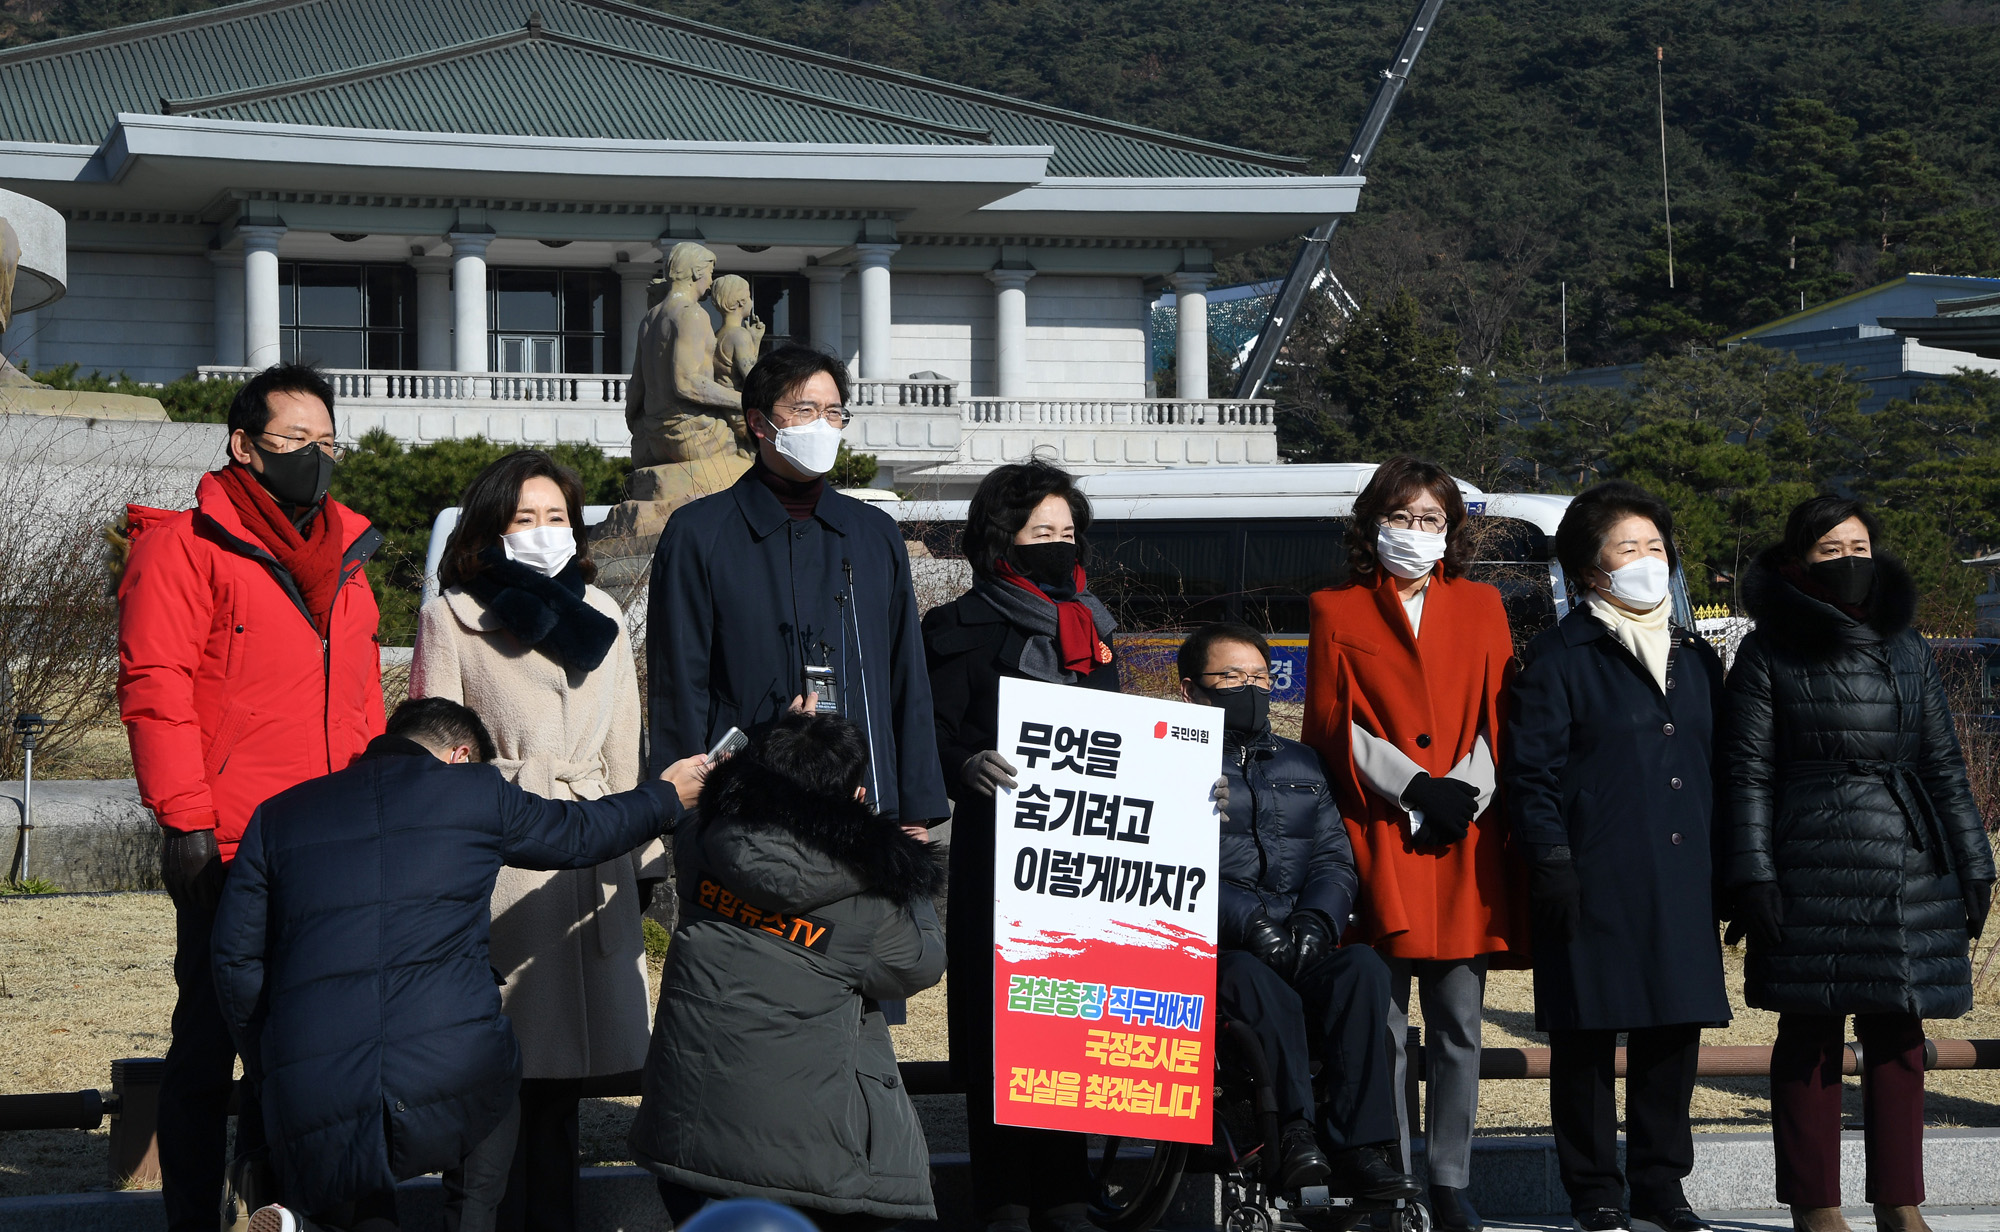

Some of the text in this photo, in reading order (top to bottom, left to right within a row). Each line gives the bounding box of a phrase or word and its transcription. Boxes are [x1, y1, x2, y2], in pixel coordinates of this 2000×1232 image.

[1463, 503, 1483, 514] 1-3
[1015, 721, 1122, 779] 무엇을
[1170, 725, 1210, 745] 국민의힘
[1014, 784, 1155, 845] 숨기려고
[1013, 846, 1207, 914] 이렇게까지?
[698, 879, 826, 948] 연합뉴스TV
[1008, 975, 1204, 1032] 검찰총장 직무배제
[1085, 1029, 1201, 1075] 국정조사로
[1008, 1067, 1201, 1120] 진실을 찾겠습니다
